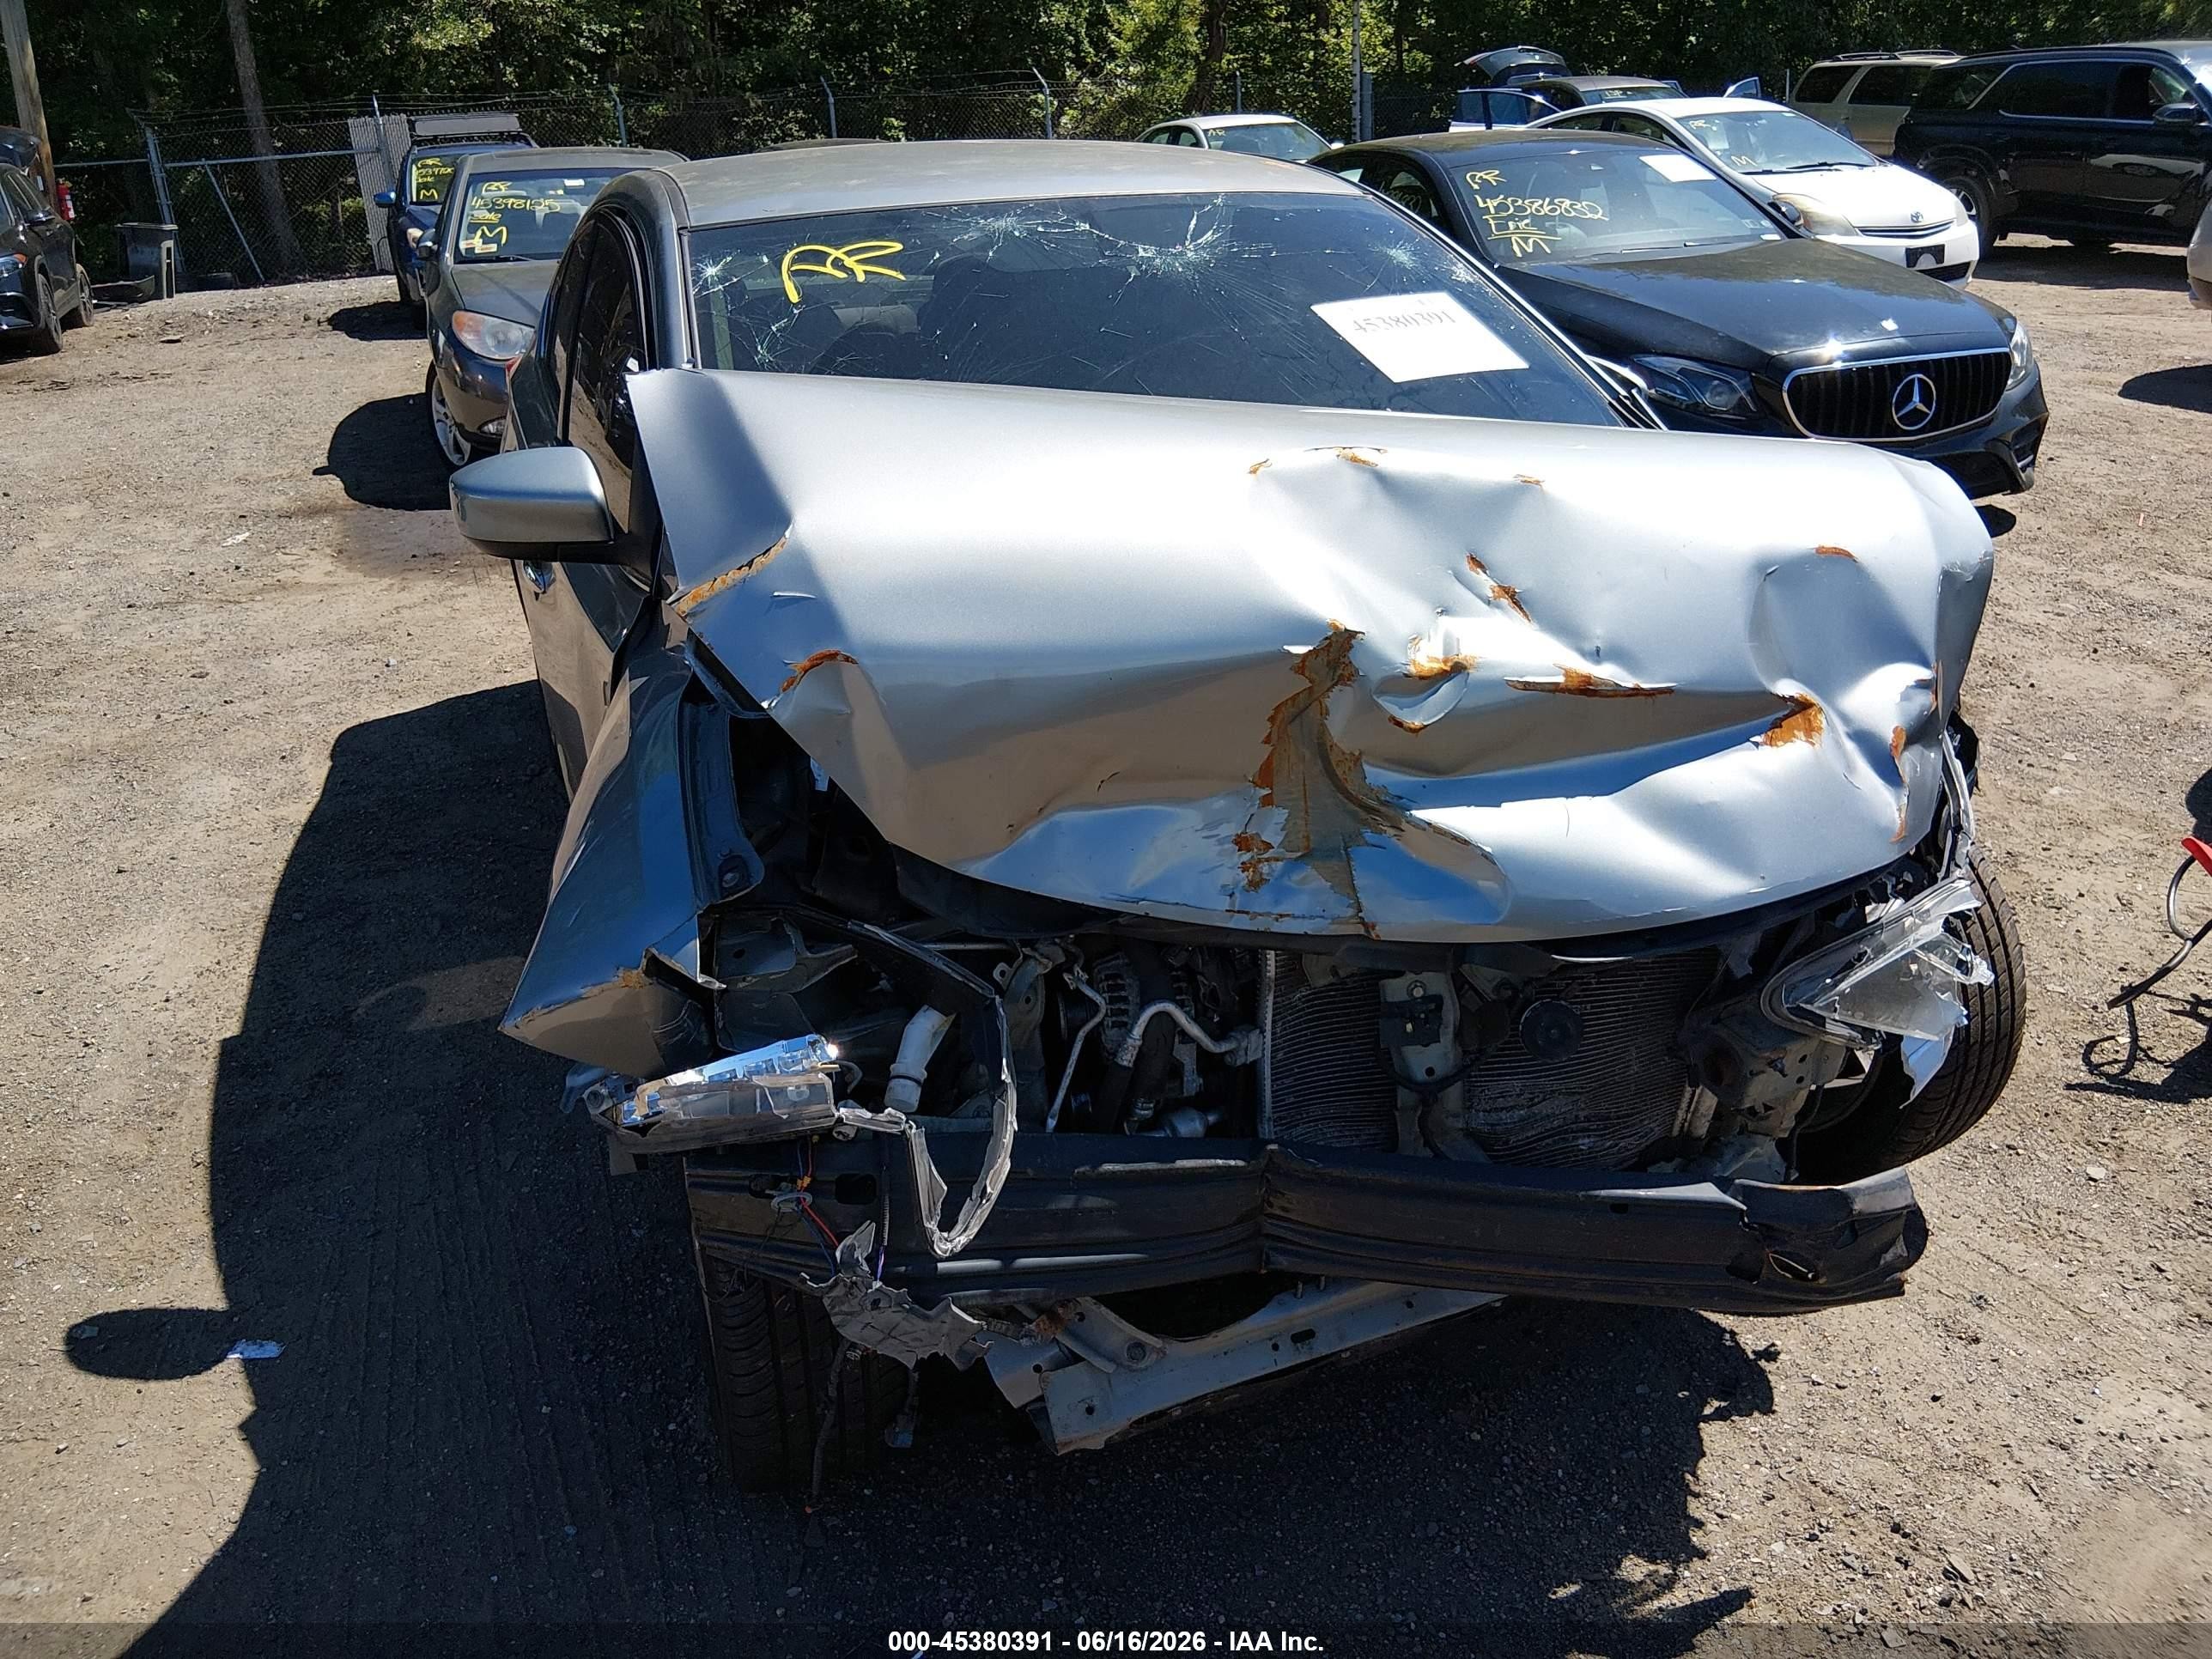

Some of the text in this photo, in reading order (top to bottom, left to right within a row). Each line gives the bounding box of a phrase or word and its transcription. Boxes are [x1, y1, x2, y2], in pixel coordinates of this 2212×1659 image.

[1730, 155, 1758, 167] M
[420, 188, 439, 200] M
[471, 195, 561, 213] 45398125
[1474, 194, 1609, 222] 45386832
[474, 225, 507, 246] M
[1510, 236, 1552, 258] M
